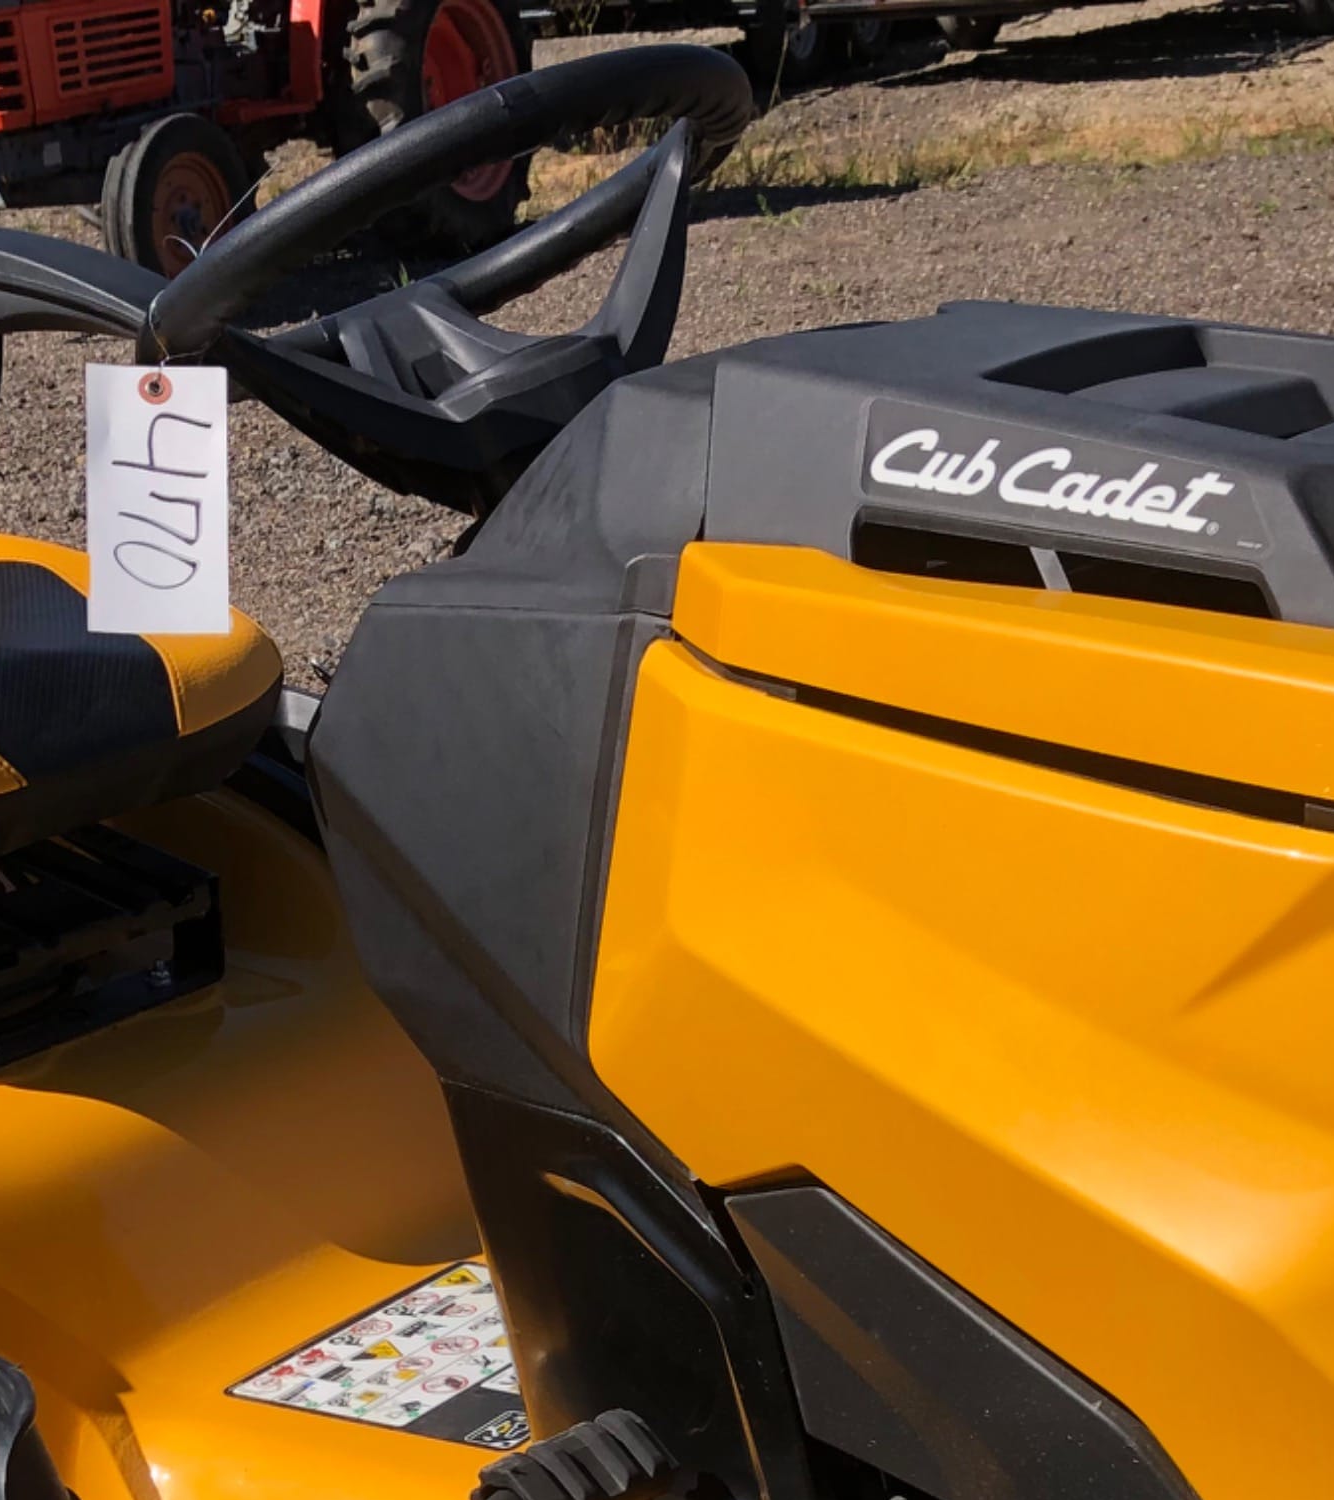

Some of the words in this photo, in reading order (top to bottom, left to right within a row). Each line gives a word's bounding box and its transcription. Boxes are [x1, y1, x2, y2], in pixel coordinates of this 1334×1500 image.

[111, 411, 213, 590] 470
[870, 428, 1001, 496] Cub
[998, 447, 1236, 534] Cadet
